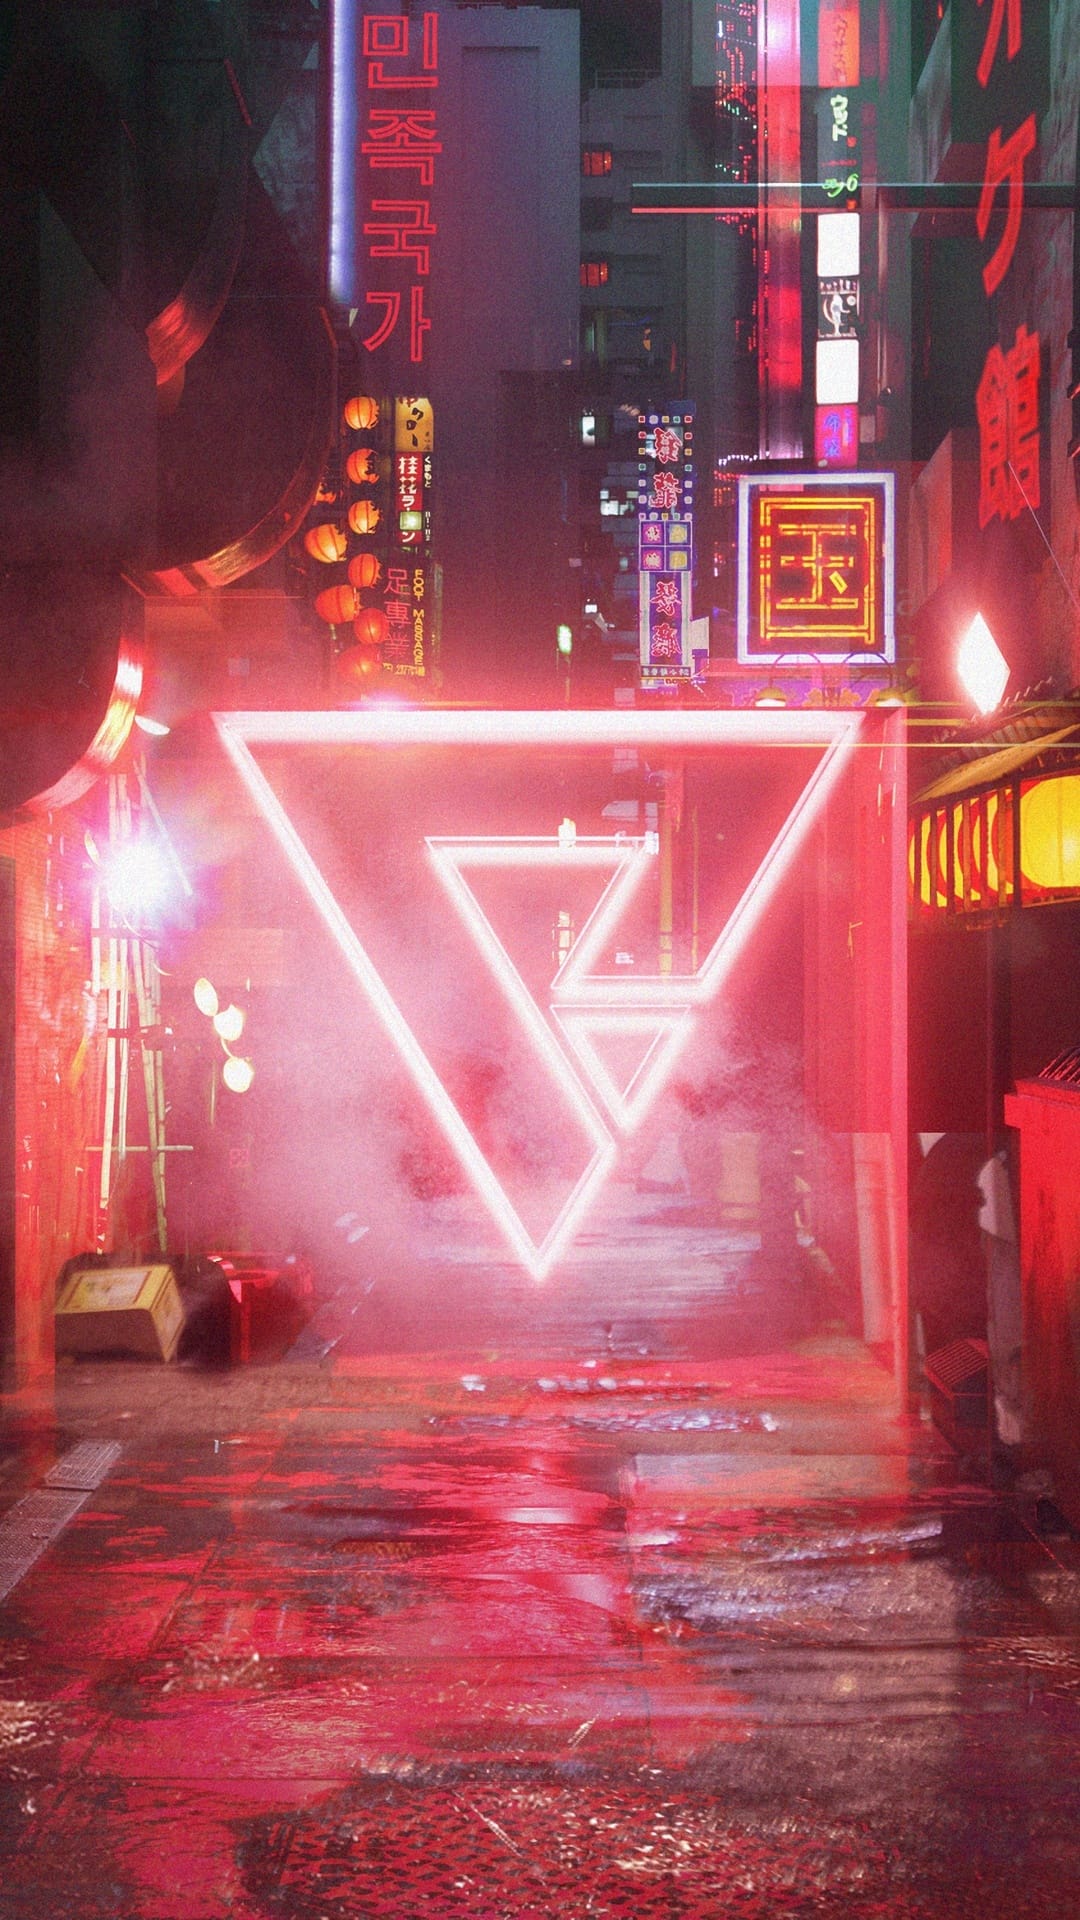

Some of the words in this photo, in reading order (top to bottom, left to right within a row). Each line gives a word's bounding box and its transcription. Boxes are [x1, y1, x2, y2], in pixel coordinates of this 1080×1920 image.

[361, 12, 442, 362] 민족국가
[412, 569, 425, 602] FOOT
[412, 609, 425, 666] MASSAGE
